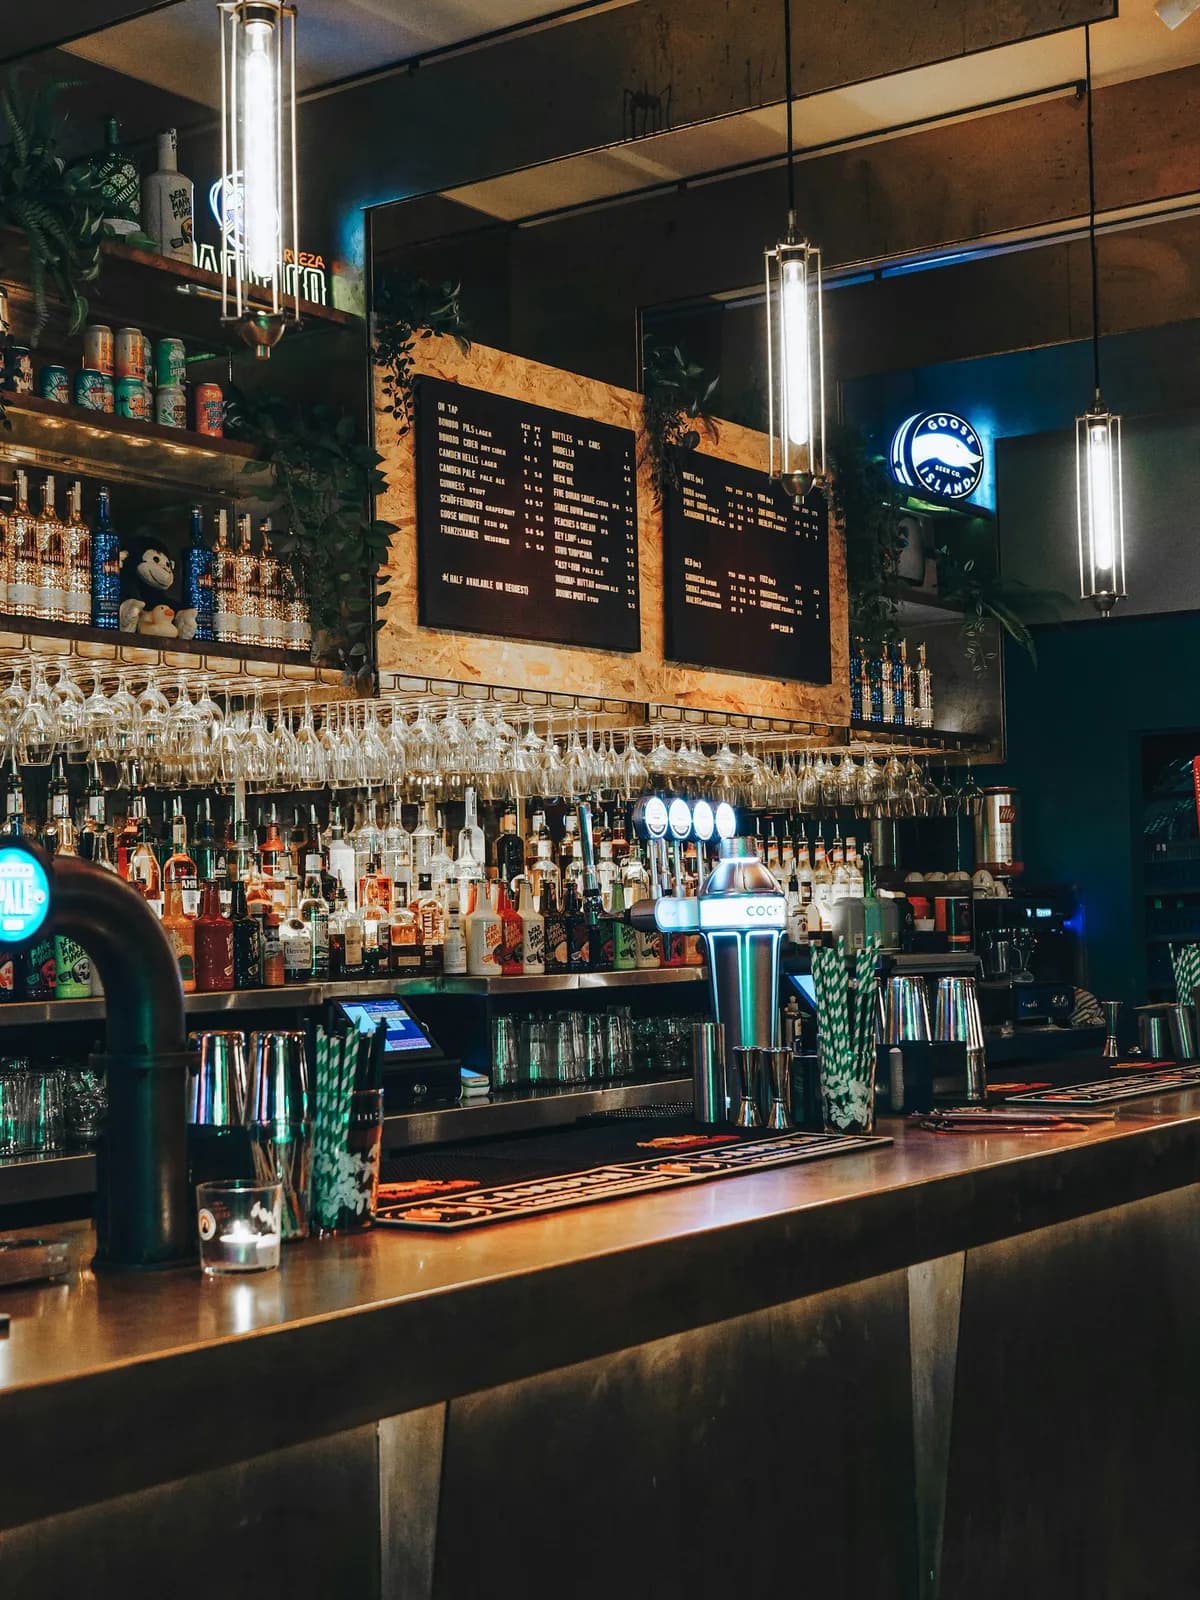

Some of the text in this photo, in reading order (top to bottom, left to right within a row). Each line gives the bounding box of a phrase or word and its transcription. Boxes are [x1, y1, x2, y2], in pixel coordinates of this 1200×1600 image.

[448, 404, 459, 414] TAP
[552, 431, 573, 443] BOTTLES
[927, 416, 975, 445] GOOSE
[439, 447, 460, 460] CAMDEN
[461, 452, 479, 464] HELLS
[439, 463, 461, 475] CAMDEN
[462, 468, 476, 479] PALE
[935, 465, 951, 474] BEER
[1000, 807, 1016, 821] illy
